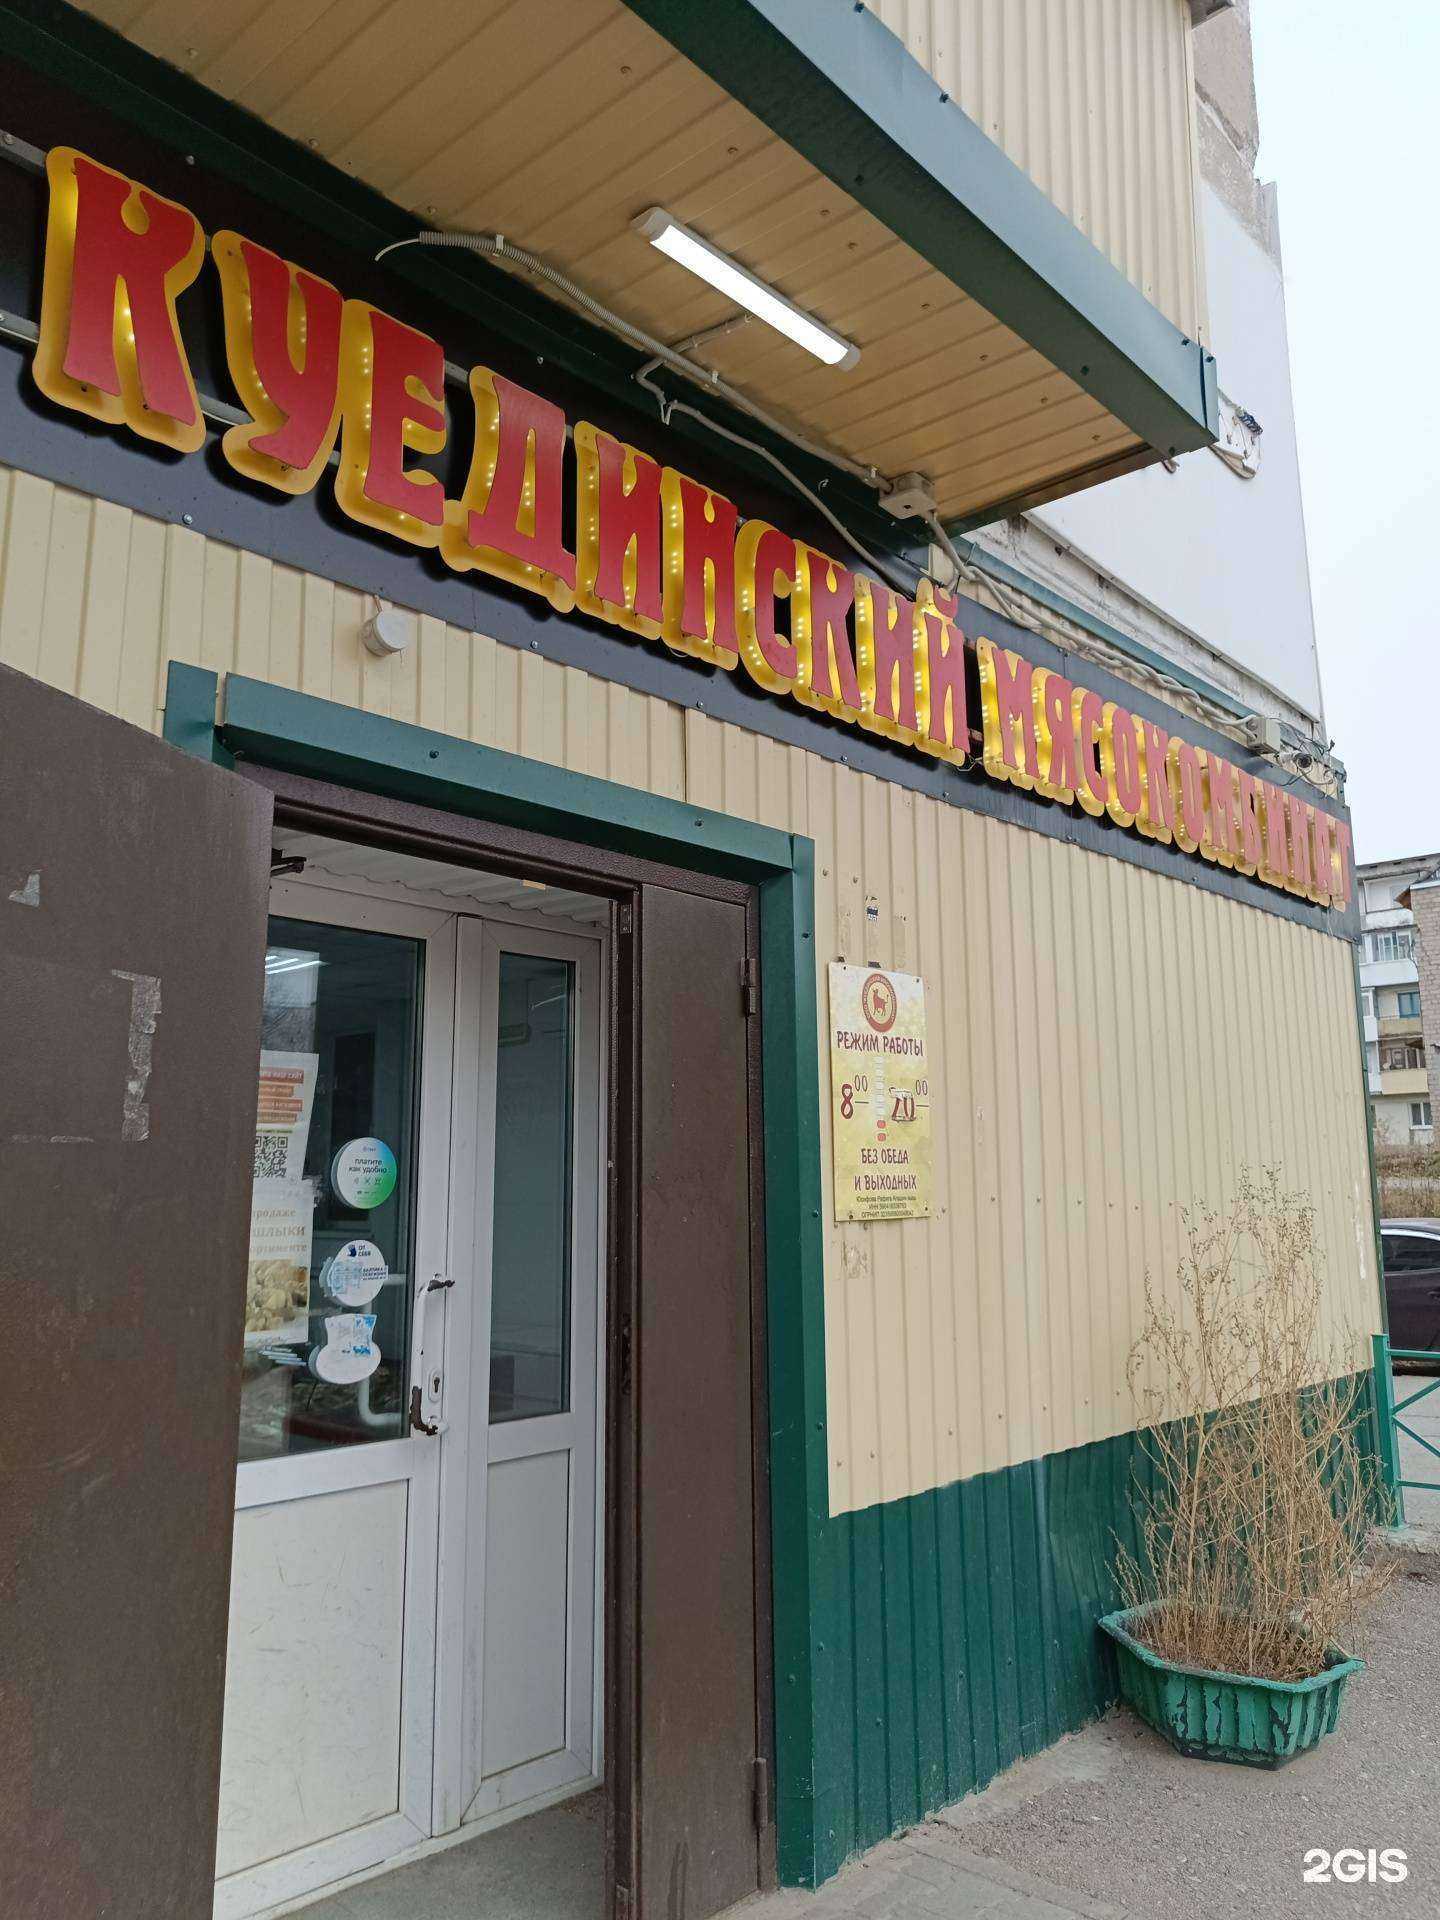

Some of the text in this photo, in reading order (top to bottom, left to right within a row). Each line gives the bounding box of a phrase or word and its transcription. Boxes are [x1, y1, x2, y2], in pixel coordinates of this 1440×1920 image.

[33, 146, 1352, 913] КУЕДИНСКИЙ МЯСОКОМБИНАТ
[836, 1031, 924, 1057] РЕЖИМ РАБОТЫ
[354, 1158, 383, 1166] платите
[861, 1148, 909, 1164] БЕЗ ОБЕДА
[362, 1165, 388, 1174] удобно
[854, 1174, 917, 1191] И ВЫХОДНЫХ
